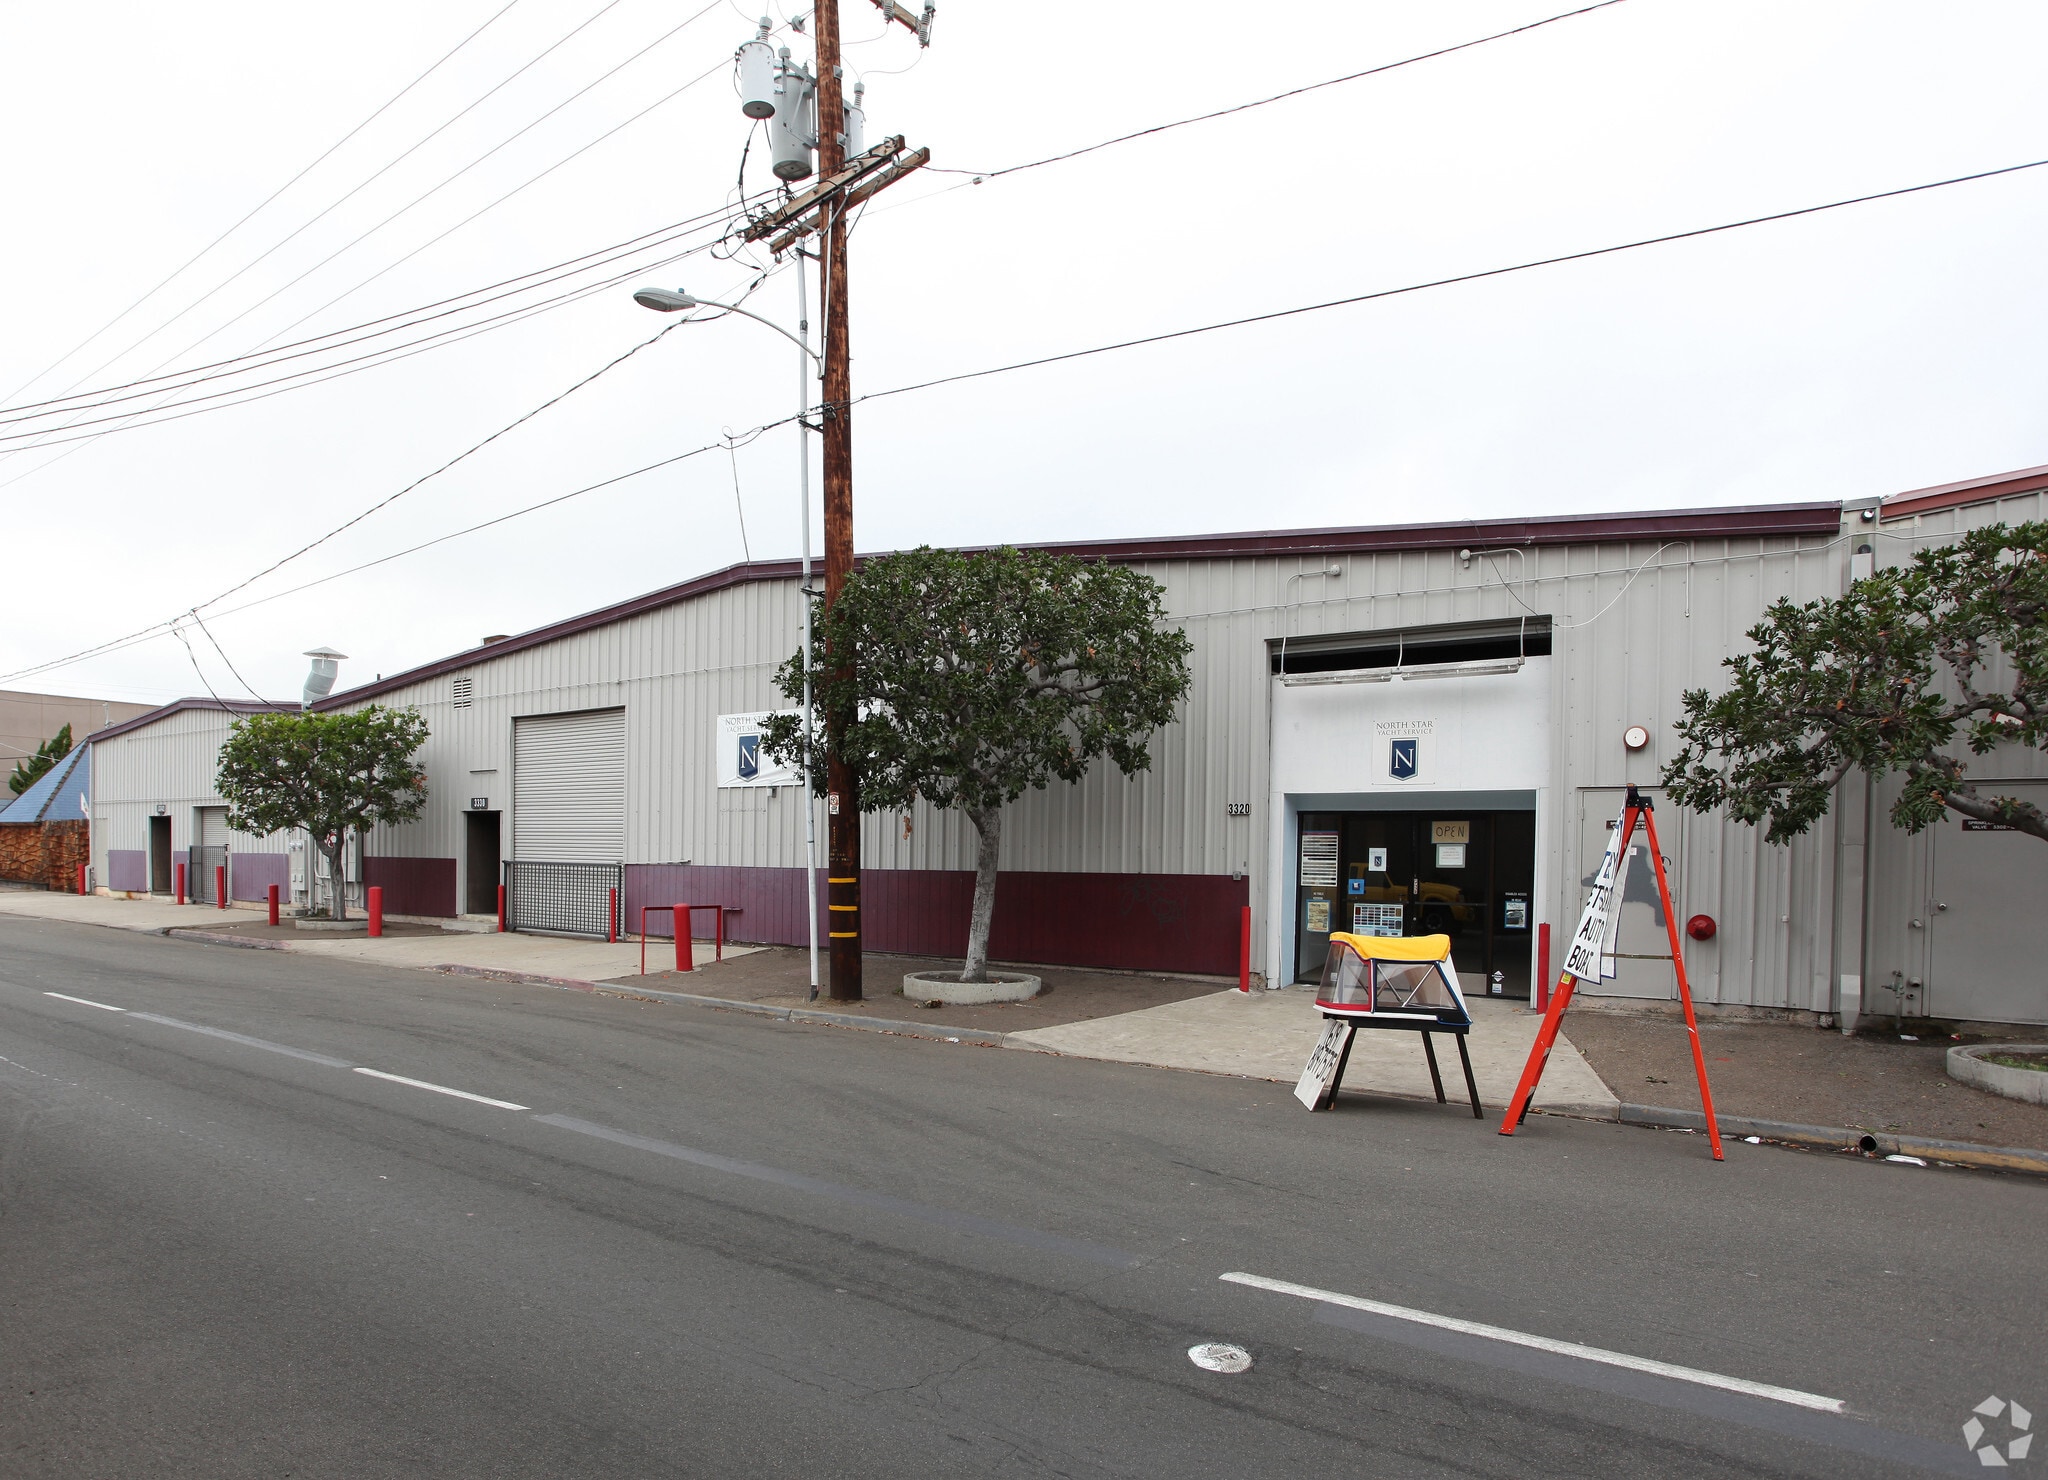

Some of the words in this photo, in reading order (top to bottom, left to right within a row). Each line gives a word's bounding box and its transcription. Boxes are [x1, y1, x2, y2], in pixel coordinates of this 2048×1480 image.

[725, 716, 751, 726] NORTH
[1376, 721, 1408, 730] NORTH
[1411, 720, 1434, 729] STAR
[740, 745, 756, 769] N
[1393, 748, 1414, 769] N
[1228, 803, 1250, 814] 3320
[1435, 825, 1465, 838] OPEN
[1579, 916, 1605, 945] AUTO
[1567, 944, 1594, 976] BOAT
